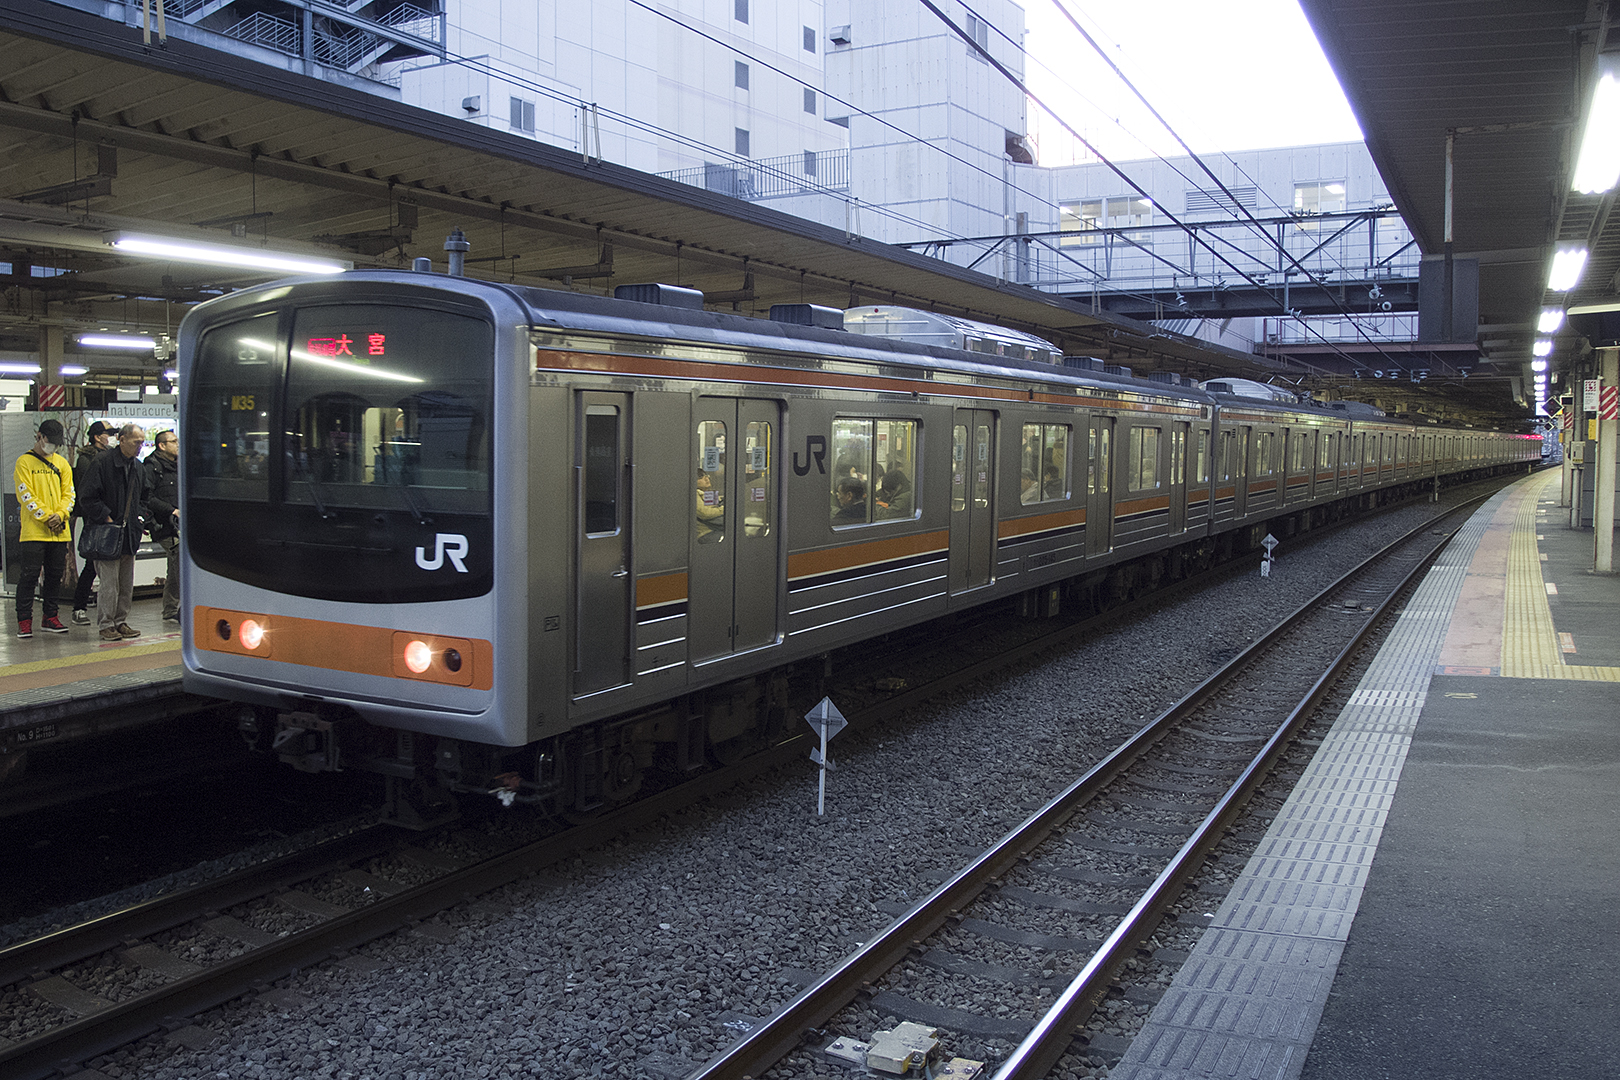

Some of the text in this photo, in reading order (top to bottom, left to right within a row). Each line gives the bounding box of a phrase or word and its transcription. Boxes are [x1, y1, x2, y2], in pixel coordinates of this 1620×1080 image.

[335, 332, 386, 356] 大宮
[110, 405, 172, 417] naturacure
[230, 394, 256, 411] M35
[793, 434, 827, 477] JR
[414, 532, 470, 573] JR
[17, 730, 34, 742] No. 9
